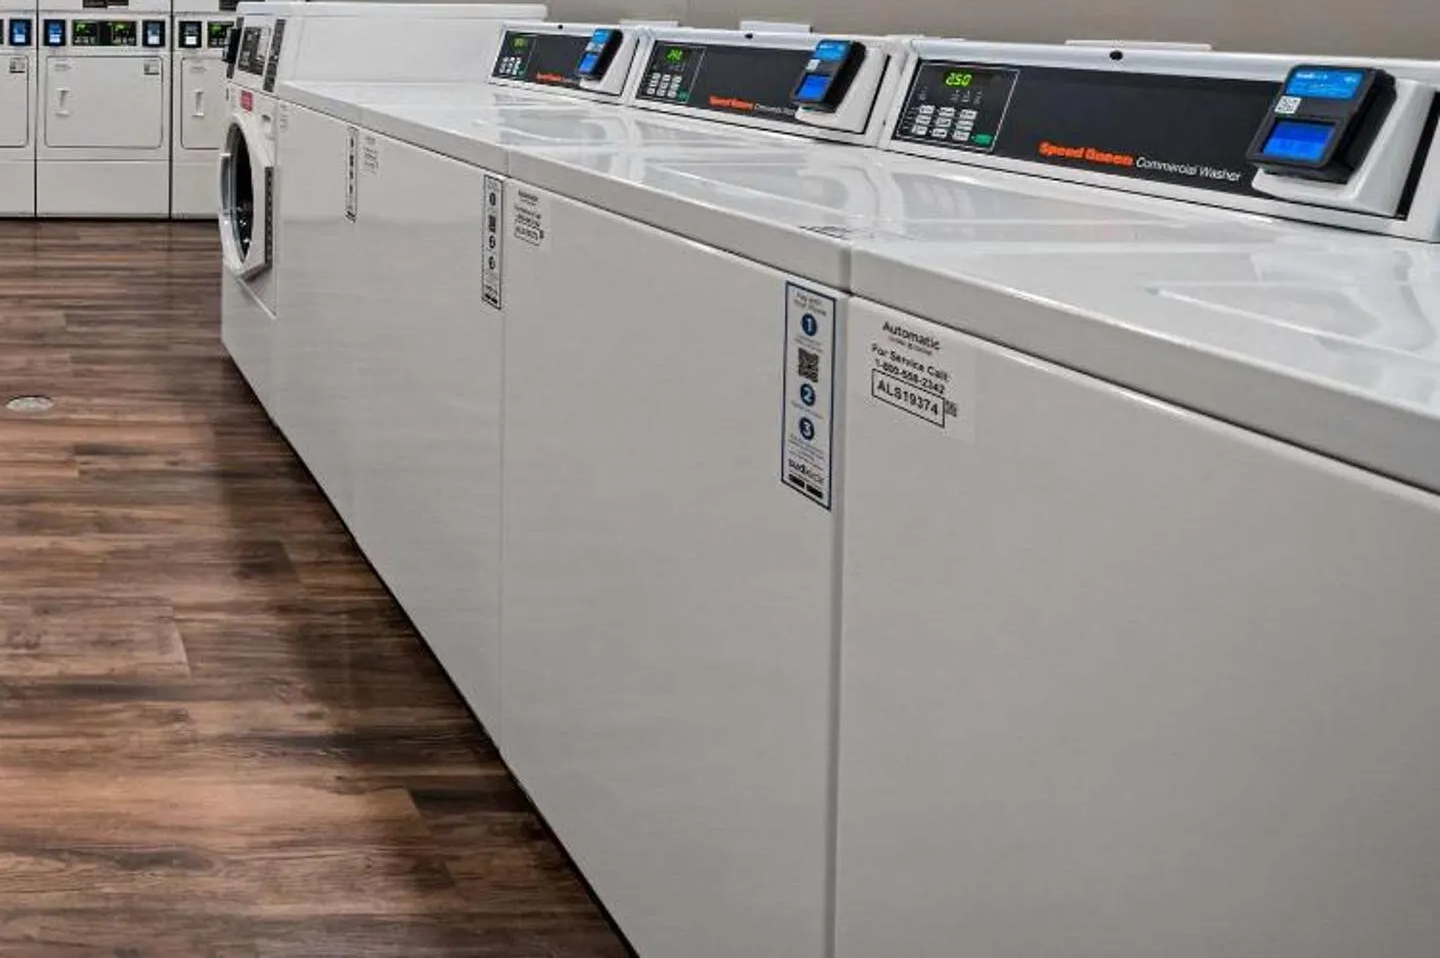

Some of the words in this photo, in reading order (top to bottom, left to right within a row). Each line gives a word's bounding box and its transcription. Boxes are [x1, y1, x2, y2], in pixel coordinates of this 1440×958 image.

[1039, 141, 1084, 159] Speed
[1085, 148, 1134, 166] Queen
[1136, 156, 1197, 176] Commercial
[1200, 166, 1241, 182] Washer
[882, 322, 940, 350] Automatic
[872, 343, 888, 356] For
[890, 350, 925, 372] Service
